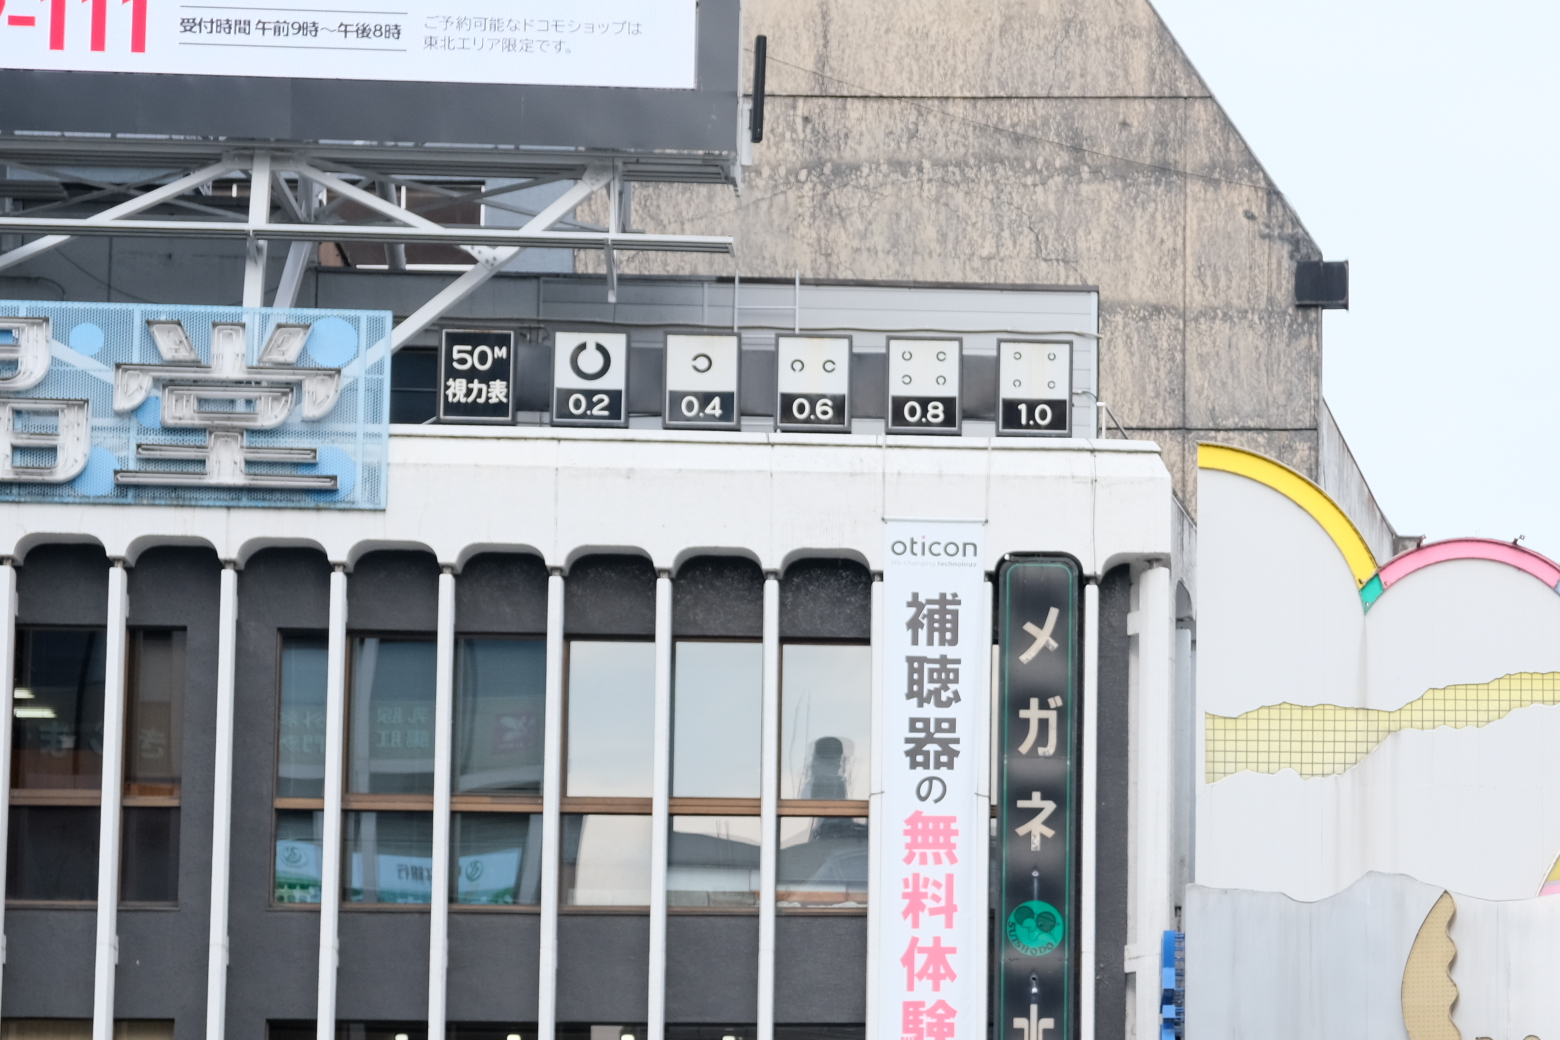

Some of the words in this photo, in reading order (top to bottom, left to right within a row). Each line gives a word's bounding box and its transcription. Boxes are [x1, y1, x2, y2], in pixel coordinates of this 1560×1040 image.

[0, 0, 147, 53] -111
[179, 18, 250, 35] 受付時間
[424, 15, 643, 36] ご予約可能なドコモショップは
[423, 36, 572, 54] 東北エリア限定です。
[446, 378, 507, 404] 視力表
[568, 394, 610, 417] 0.2
[681, 396, 723, 419] 0.4
[792, 398, 834, 421] 0.6
[904, 401, 945, 424] 0.8
[1017, 403, 1052, 426] 1.0
[890, 535, 978, 558] oticon
[1014, 605, 1064, 853] メガネ
[1007, 920, 1055, 956] SUISHODO
